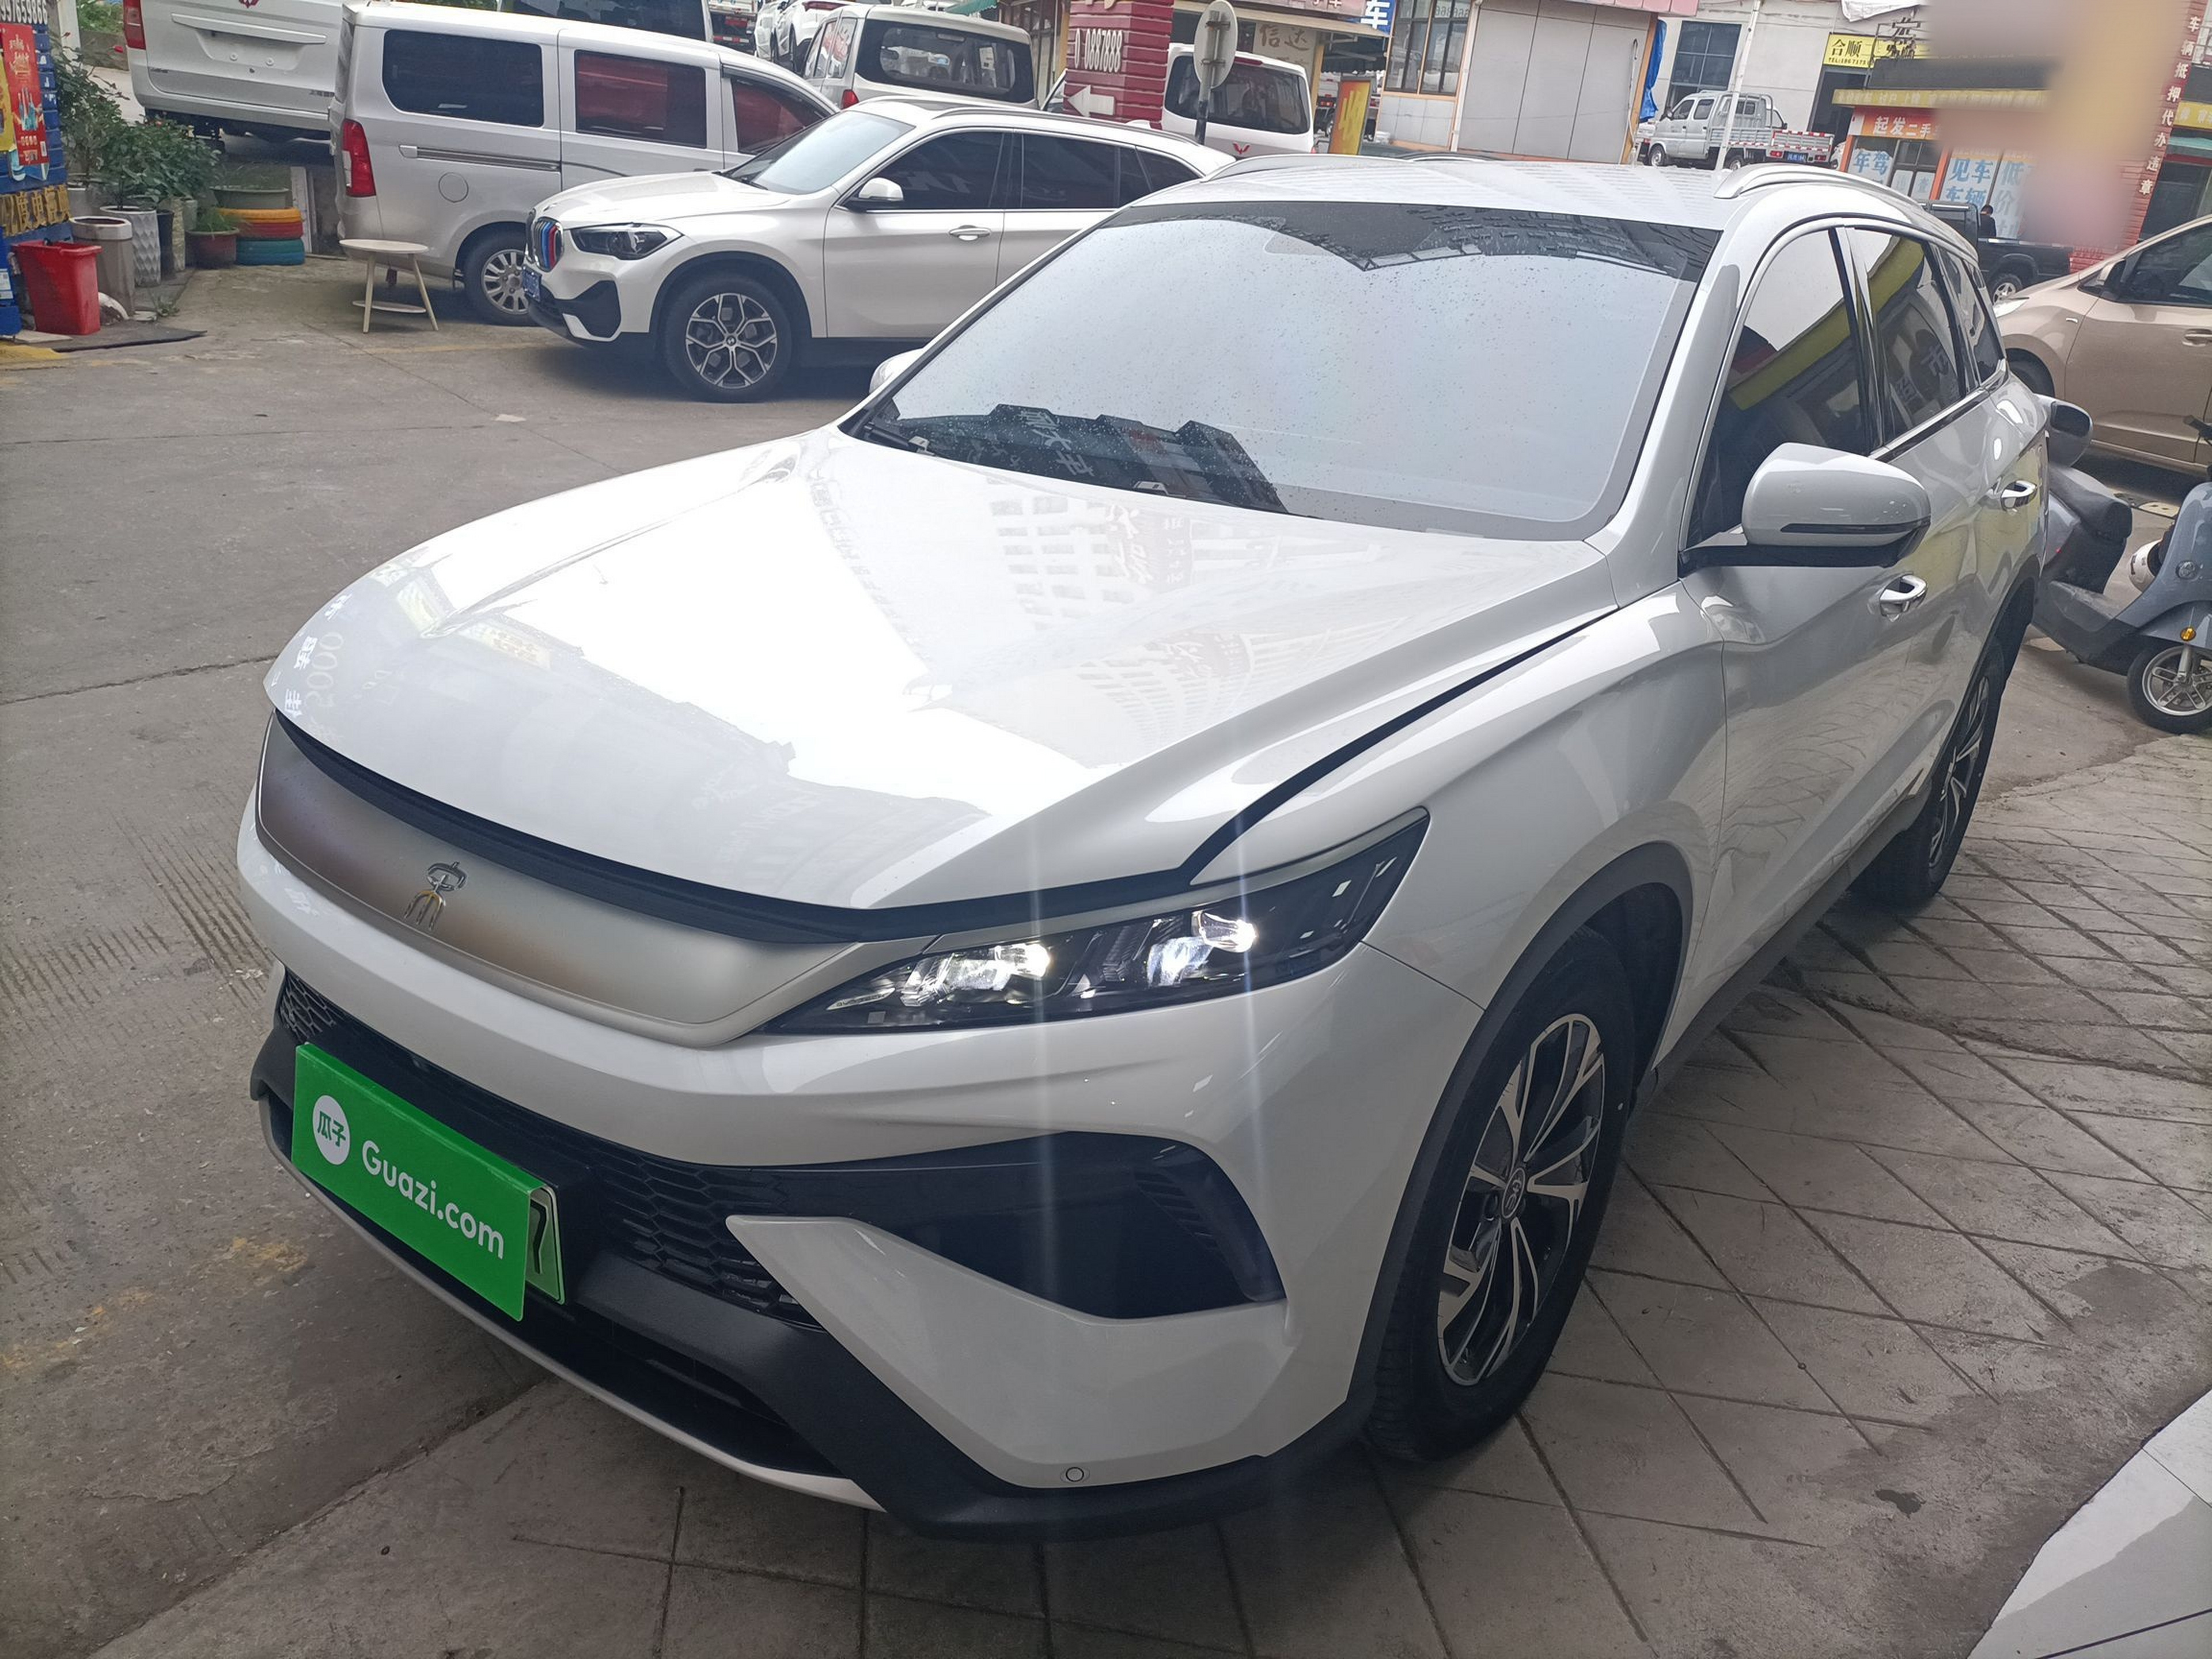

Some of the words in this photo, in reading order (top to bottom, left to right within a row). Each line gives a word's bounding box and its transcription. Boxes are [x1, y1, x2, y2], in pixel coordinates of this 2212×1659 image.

[1260, 25, 1310, 51] 信达
[317, 1110, 346, 1147] 瓜子
[362, 1140, 505, 1260] Guazi.com
